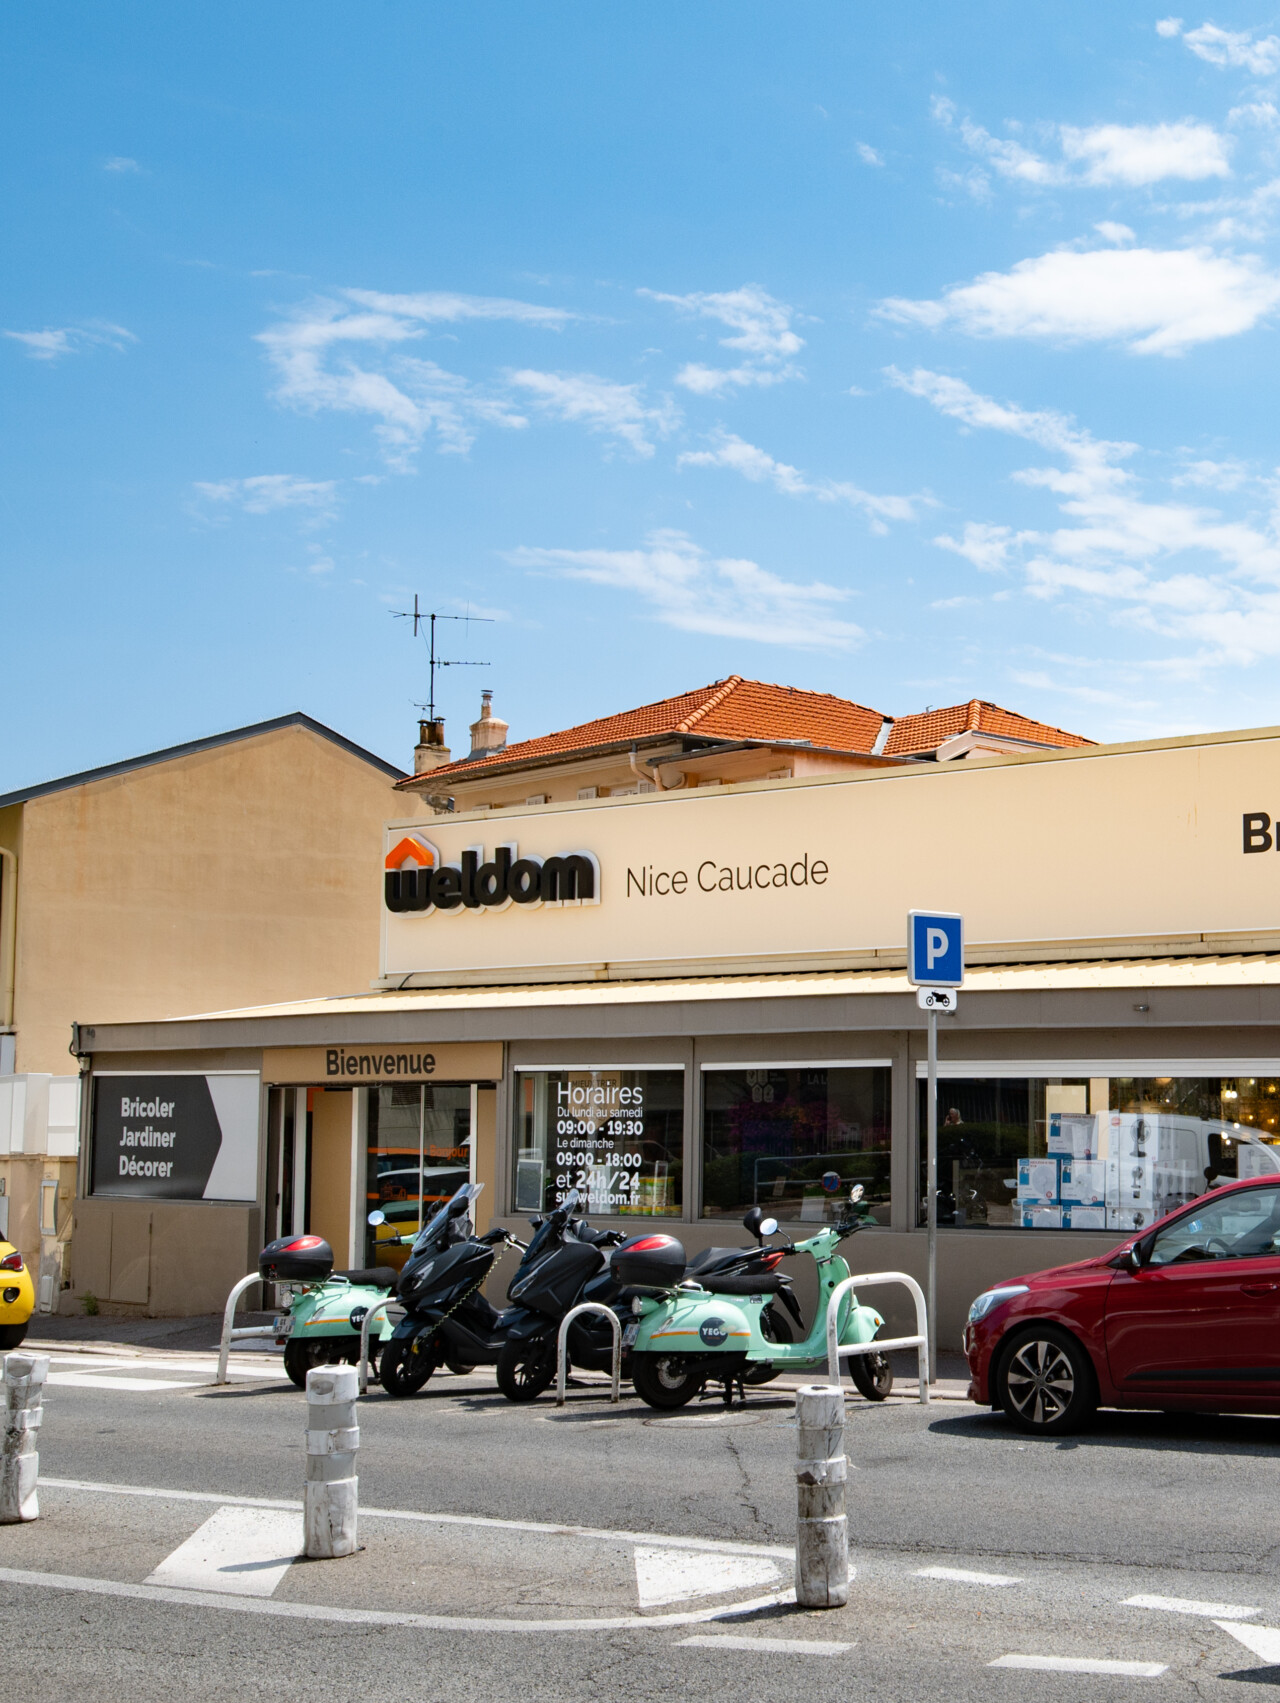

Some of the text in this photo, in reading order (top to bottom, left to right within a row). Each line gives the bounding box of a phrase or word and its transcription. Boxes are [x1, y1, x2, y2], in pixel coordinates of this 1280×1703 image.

[385, 846, 597, 914] weldom
[626, 853, 829, 898] Nice Caucade
[926, 927, 949, 970] P
[326, 1049, 436, 1076] Bienvenue
[557, 1081, 643, 1105] Horaires
[120, 1096, 176, 1118] Bricoler
[557, 1106, 643, 1118] Du lundi au samedi
[119, 1126, 177, 1148] Jardiner
[556, 1120, 596, 1135] 09:00
[607, 1121, 644, 1135] 19:30
[430, 1145, 468, 1160] Bonjour
[556, 1138, 614, 1149] Le dimanche
[118, 1154, 174, 1178] Décorer
[556, 1152, 594, 1166] 09:00
[605, 1153, 642, 1167] 18:00
[556, 1170, 640, 1190] et 24h/24
[577, 1190, 641, 1206] weldom.fr
